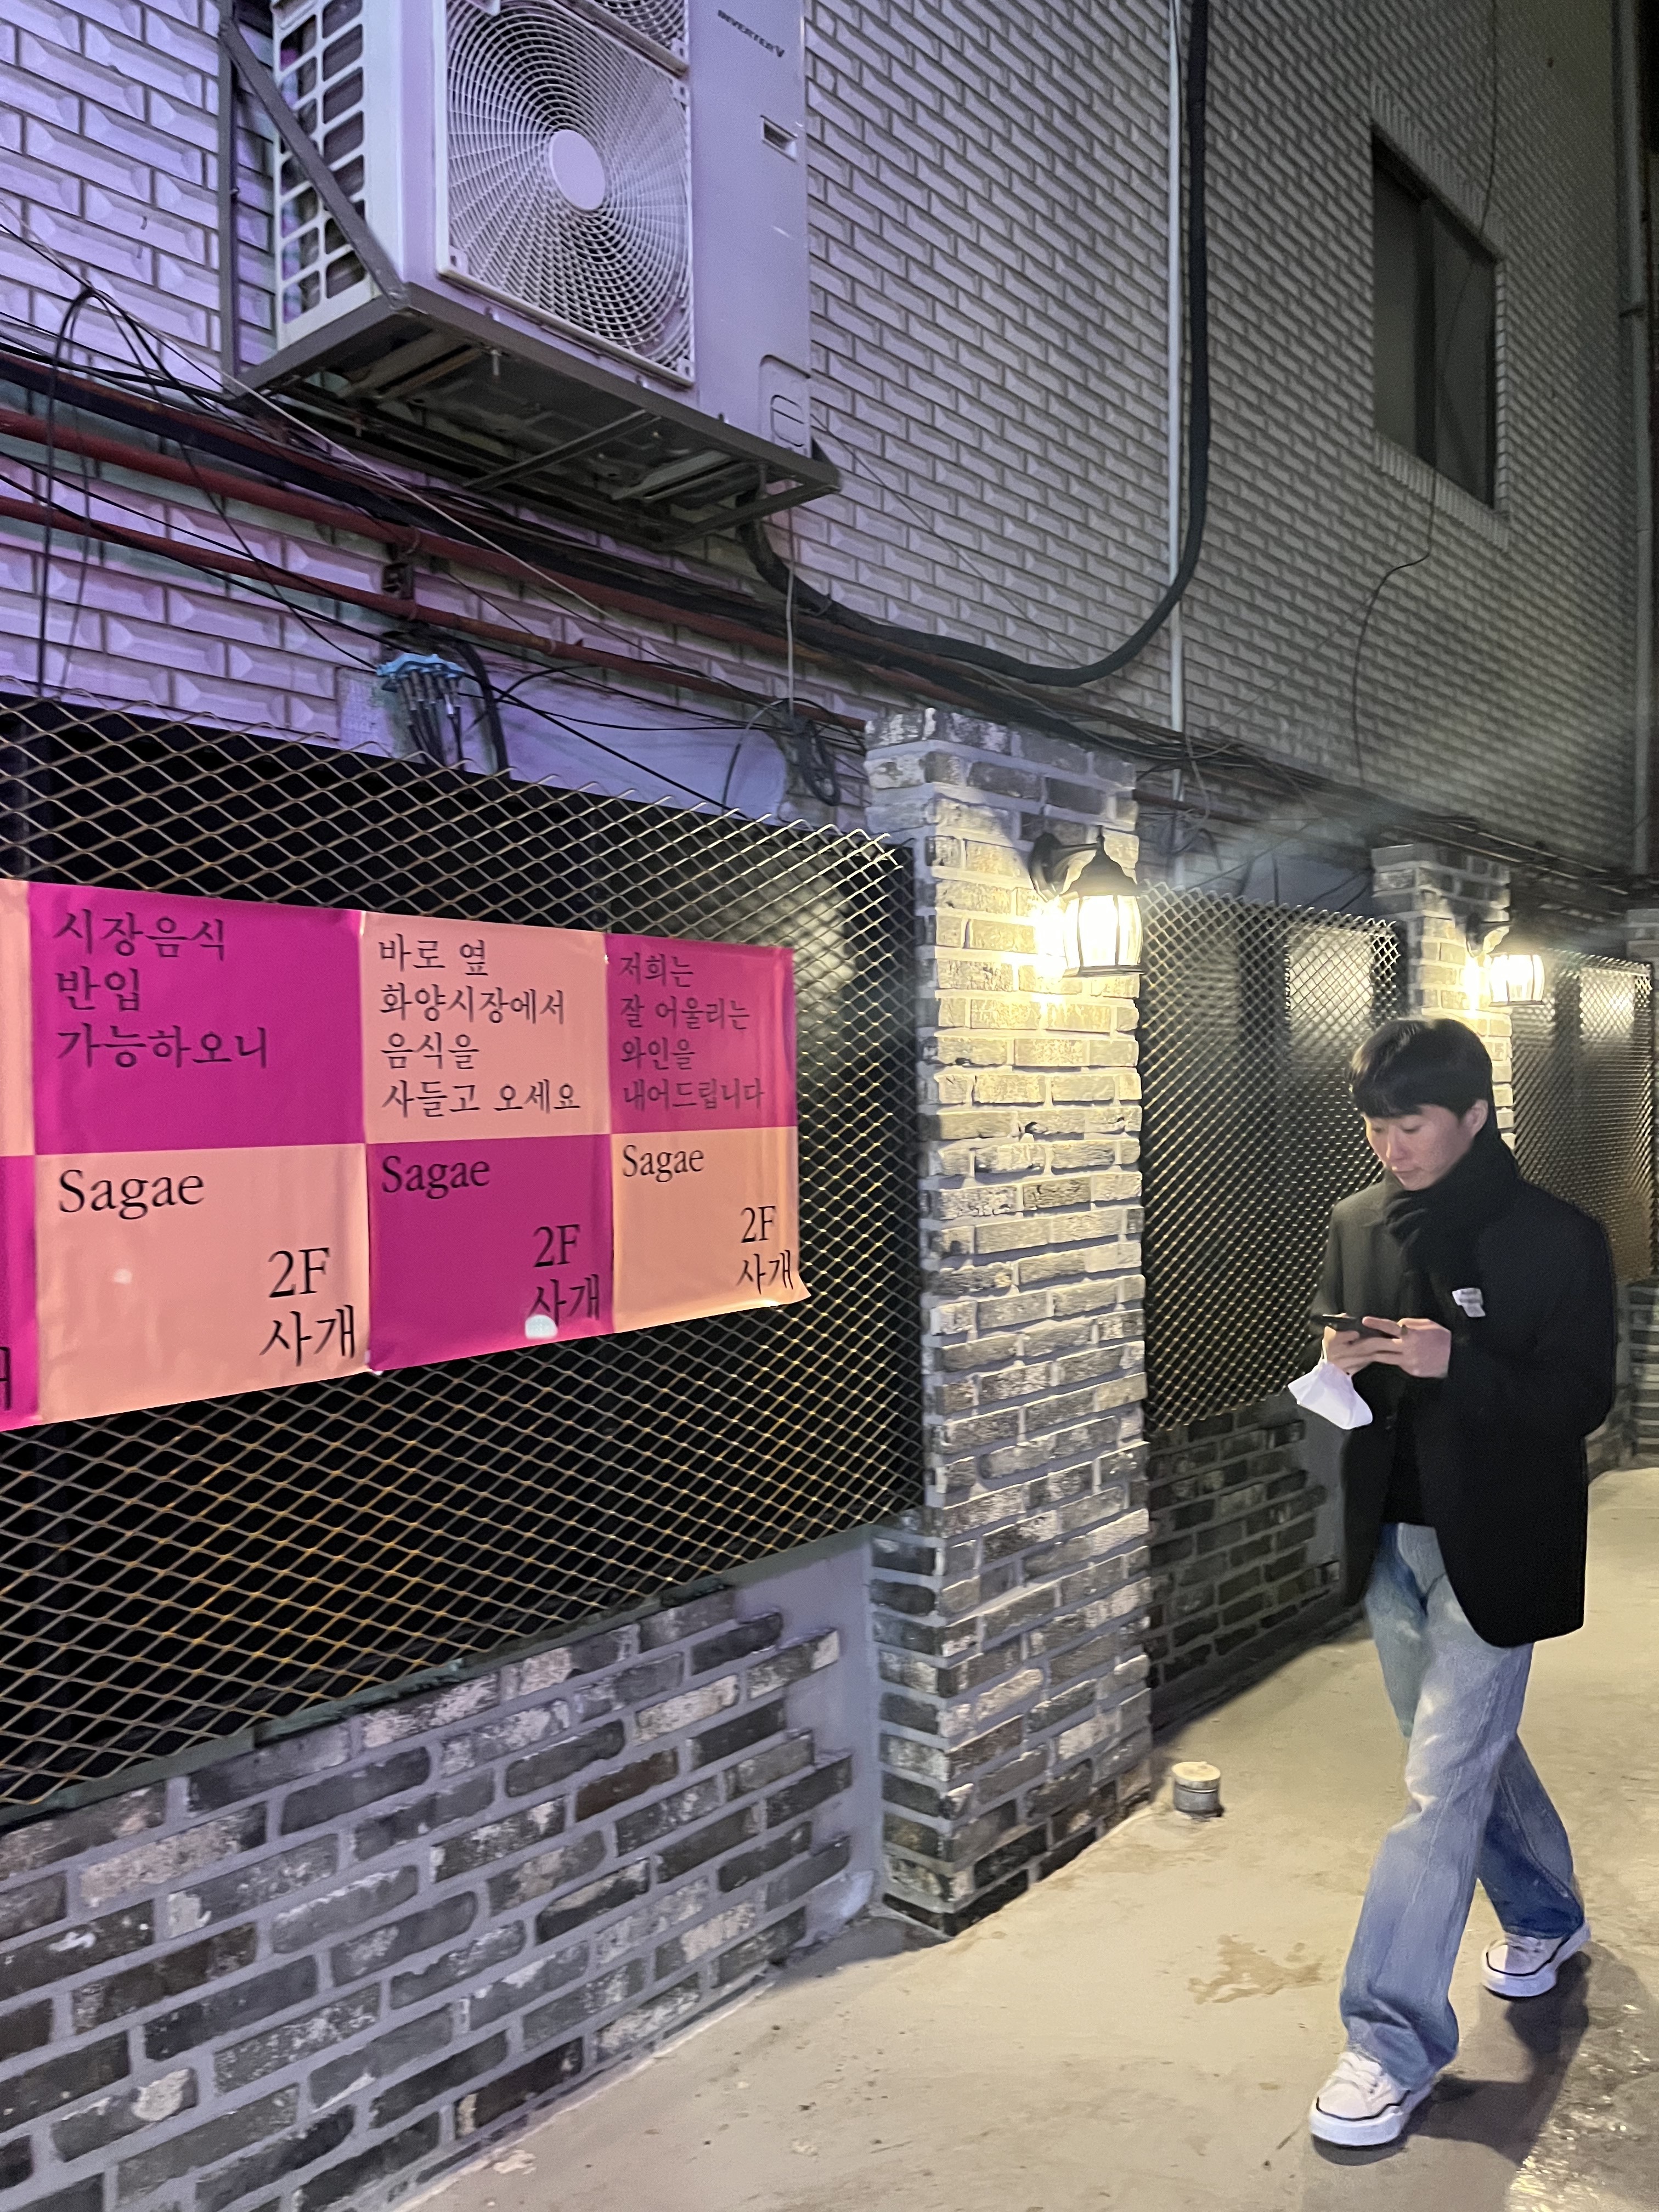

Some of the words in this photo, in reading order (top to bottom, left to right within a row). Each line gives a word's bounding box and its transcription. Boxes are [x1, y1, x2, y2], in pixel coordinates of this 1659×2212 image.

[55, 909, 224, 961] 시장음식
[378, 933, 446, 972] 바로
[459, 939, 489, 977] 옆
[55, 966, 140, 1012] 반입
[619, 952, 694, 988] 저희는
[379, 982, 564, 1025] 화양시장에서
[621, 994, 645, 1028] 잘
[655, 995, 750, 1030] 어울리는
[57, 1022, 267, 1068] 가능하오니
[380, 1031, 480, 1070] 음식을
[620, 1036, 696, 1070] 와인을
[382, 1079, 481, 1118] 사들고
[493, 1079, 581, 1114] 오세요
[623, 1077, 764, 1110] 내어드립니다
[382, 1155, 490, 1199] Sagae
[623, 1144, 704, 1183] Sagae
[59, 1169, 205, 1220] Sagae
[533, 1223, 580, 1268] 2F
[740, 1205, 776, 1243] 2F
[268, 1247, 330, 1298] 2F
[737, 1249, 793, 1295] 사개
[529, 1273, 600, 1327] 사개
[259, 1304, 356, 1367] 사개
